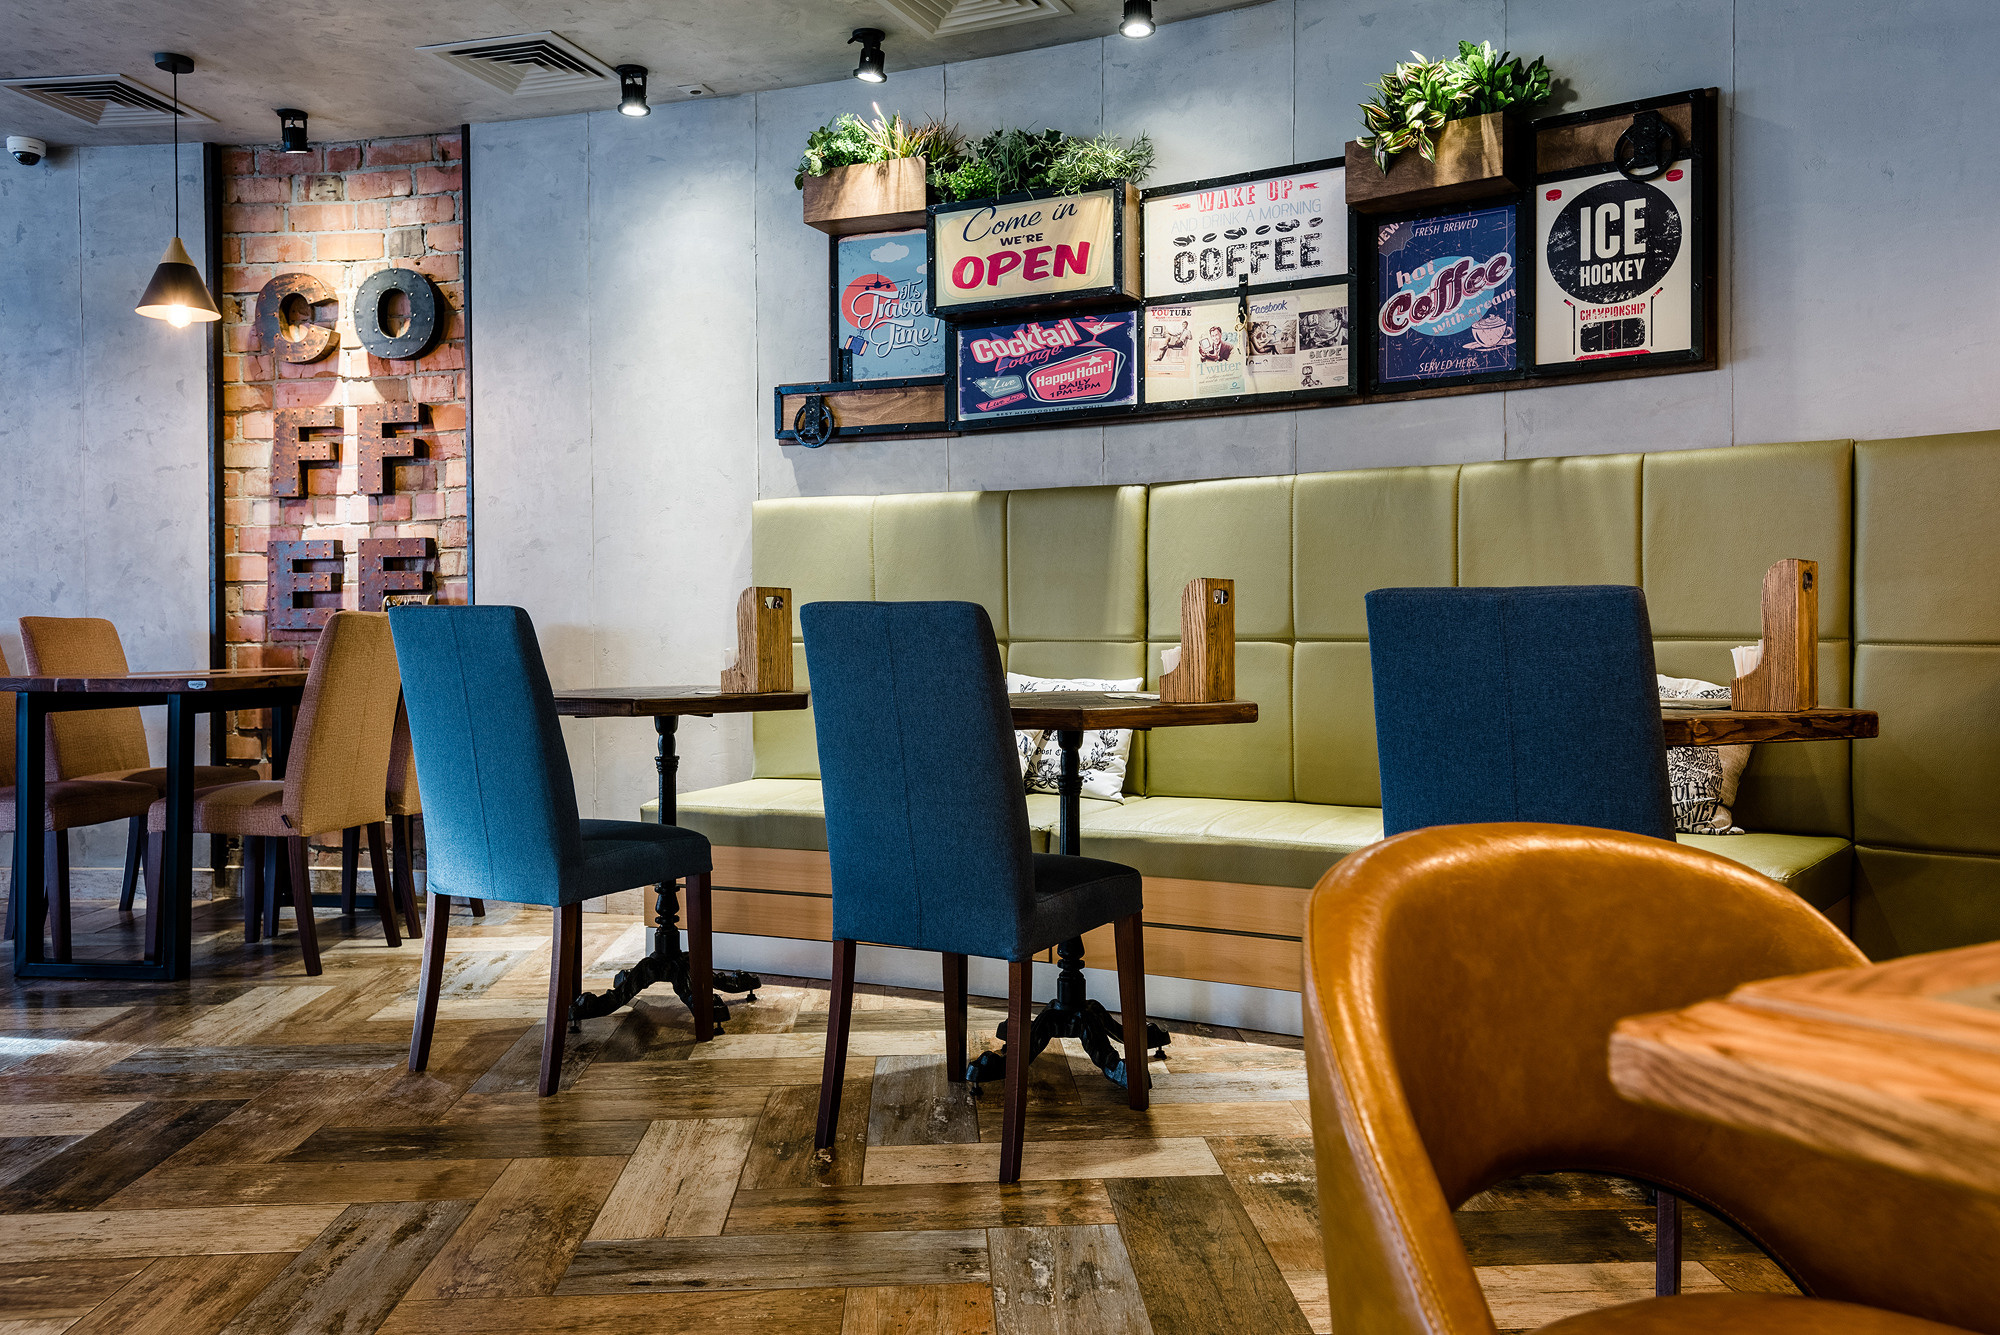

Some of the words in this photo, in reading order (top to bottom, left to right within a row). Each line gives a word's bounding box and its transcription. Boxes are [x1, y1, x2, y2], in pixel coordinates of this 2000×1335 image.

[1196, 184, 1256, 213] WAKE
[1266, 179, 1293, 202] UP
[963, 205, 1043, 242] Come
[1052, 203, 1078, 221] in
[1171, 218, 1198, 234] AND
[1202, 213, 1240, 229] DRINK
[1245, 209, 1255, 222] A
[1259, 198, 1322, 220] MORNING
[1414, 225, 1441, 238] FRESH
[1442, 218, 1479, 233] BREWED
[1580, 197, 1647, 262] ICE
[1000, 232, 1044, 247] WE'RE
[1378, 221, 1405, 248] NEW
[952, 241, 1091, 290] OPEN
[1173, 233, 1323, 284] COFFEE
[1579, 258, 1646, 287] HOCKEY
[1395, 259, 1435, 289] hot
[899, 279, 924, 300] It's
[1381, 254, 1510, 335] Coffee
[851, 289, 929, 330] Travel
[1151, 309, 1192, 317] YOUTUBE
[1249, 299, 1288, 316] Facebook
[1432, 313, 1466, 335] with
[1467, 288, 1516, 317] cream
[1580, 303, 1646, 321] CHAMPIONSHIP
[869, 318, 941, 358] Time!
[970, 317, 1082, 364] Cocktail
[994, 345, 1063, 373] Lounge
[1309, 347, 1343, 360] SKYPE
[1418, 359, 1452, 373] SERVED
[1452, 357, 1477, 370] HERE
[1036, 373, 1076, 389] Happy
[1076, 360, 1113, 380] Hour!
[1197, 361, 1242, 376] Twitter
[1050, 382, 1101, 399] 1PM-5PM
[1058, 378, 1091, 391] DAILY
